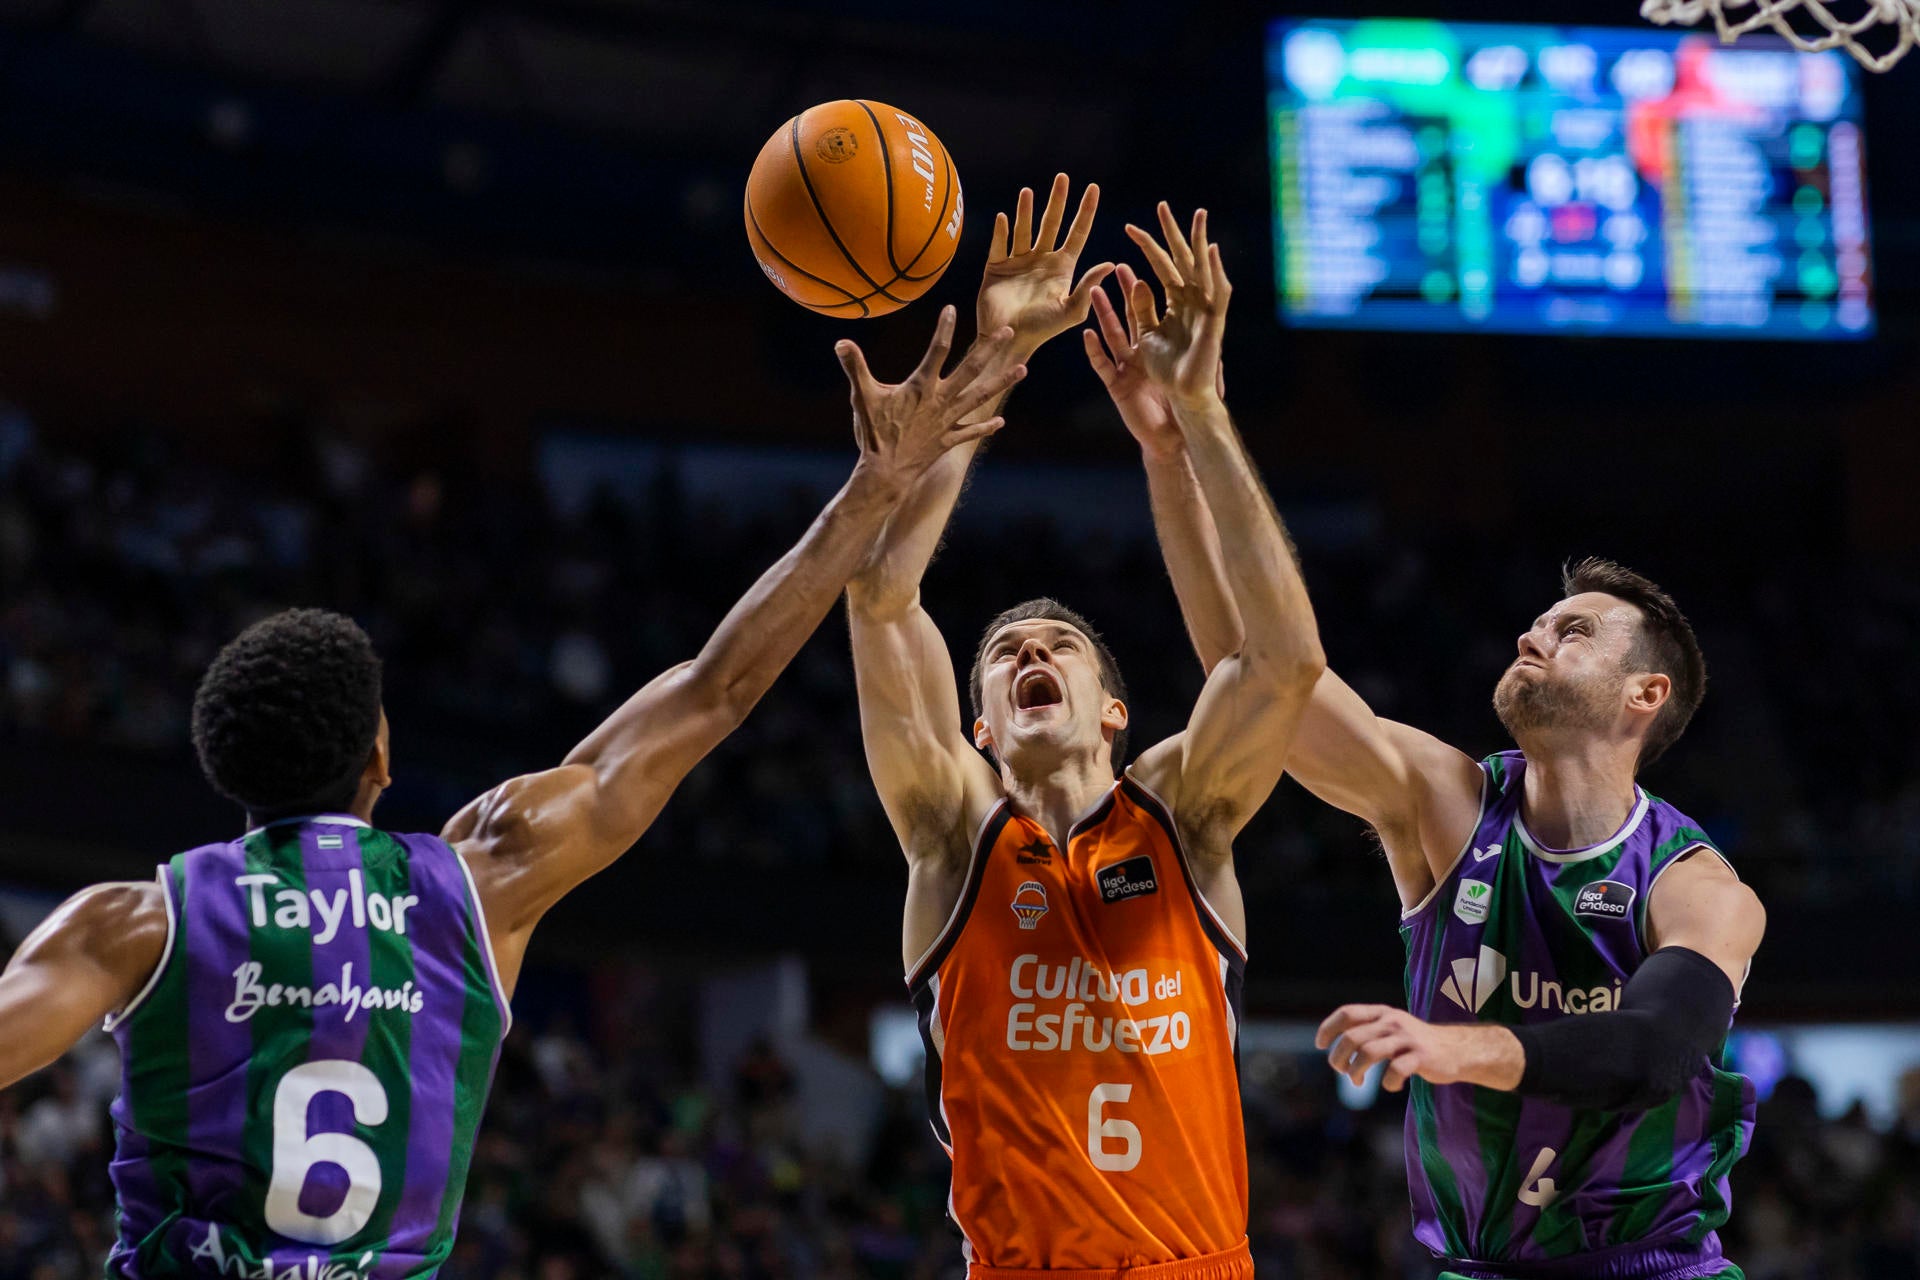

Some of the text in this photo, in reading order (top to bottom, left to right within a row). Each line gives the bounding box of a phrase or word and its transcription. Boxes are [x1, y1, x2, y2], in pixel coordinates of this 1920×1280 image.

[895, 113, 935, 213] EVO NXT
[235, 868, 419, 945] Taylor
[1103, 875, 1127, 889] liga
[1106, 880, 1155, 898] endesa
[1579, 901, 1625, 913] endesa
[1582, 890, 1603, 902] liga
[1010, 954, 1182, 1006] Cultura del
[1006, 1003, 1191, 1055] Esfuerzo
[264, 1059, 389, 1246] 6
[1088, 1083, 1142, 1171] 6
[1518, 1147, 1559, 1206] 4
